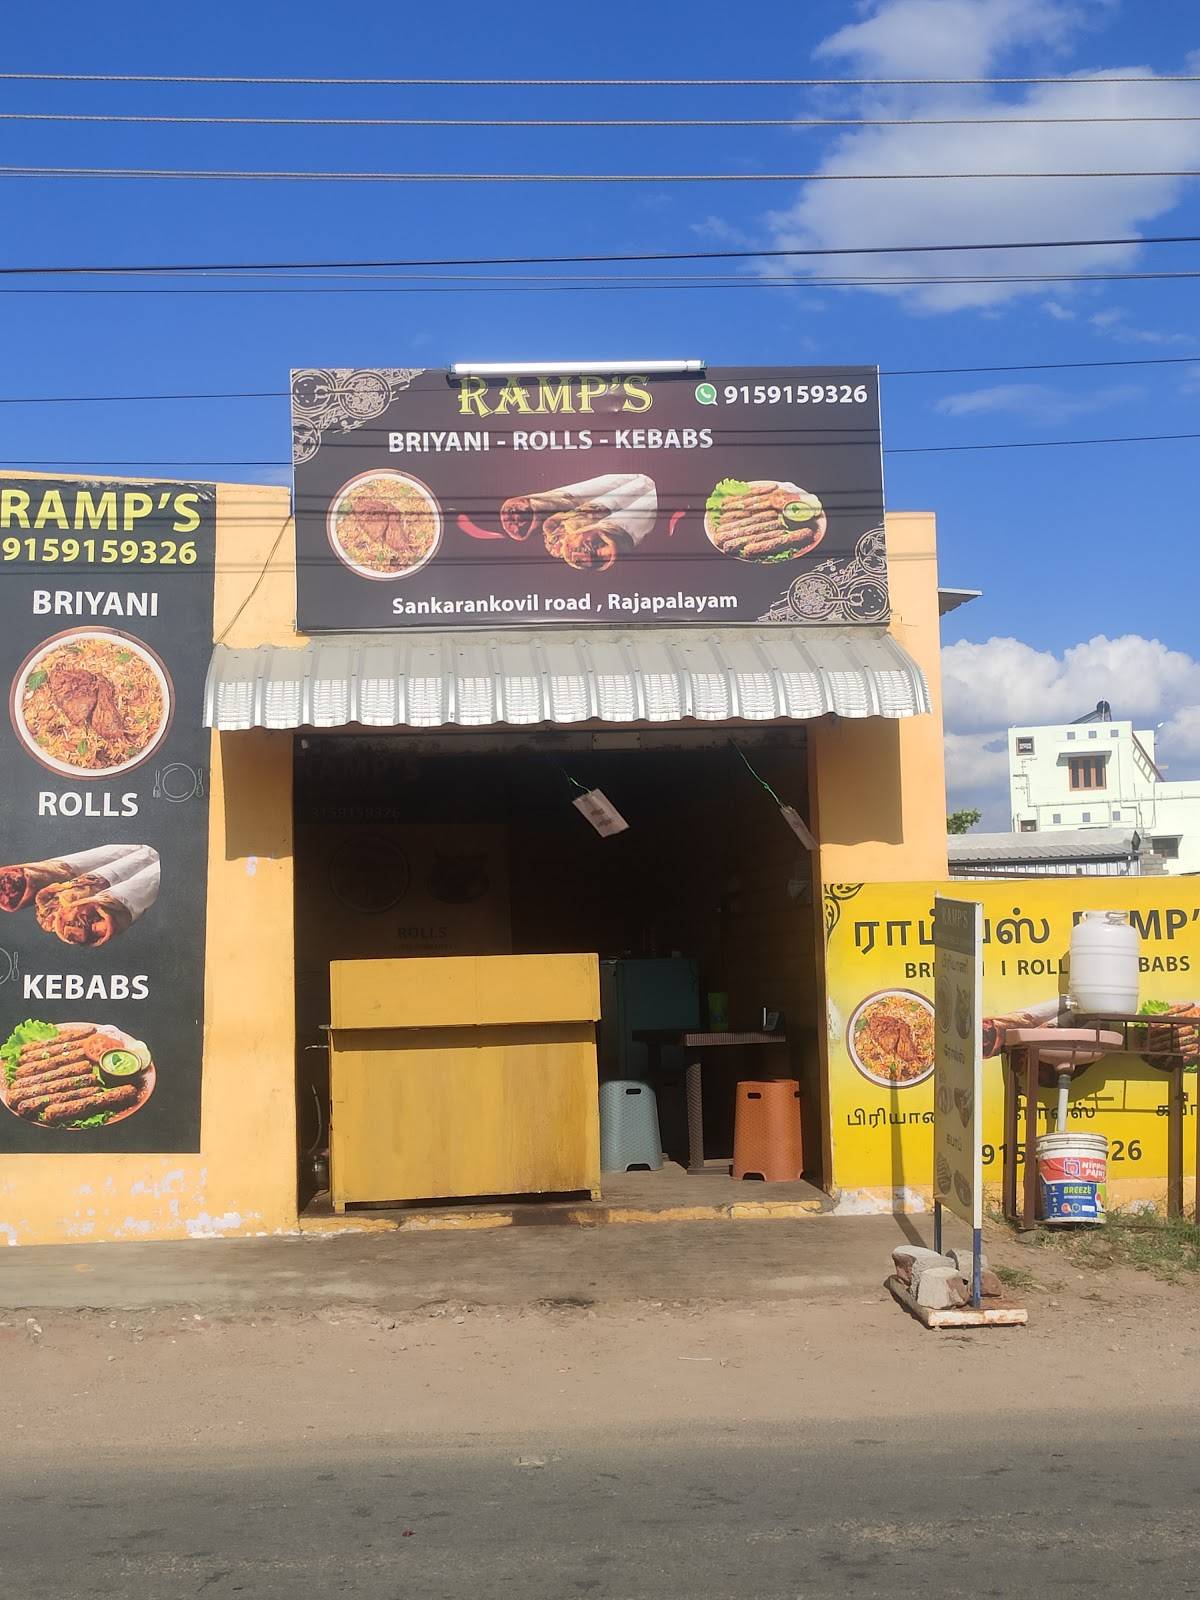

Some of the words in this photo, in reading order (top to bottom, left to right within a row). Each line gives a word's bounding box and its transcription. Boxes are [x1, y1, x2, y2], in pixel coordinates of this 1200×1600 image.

[457, 376, 653, 417] RAMP'S
[723, 385, 868, 404] 9159159326
[388, 431, 490, 453] BRIYANI
[513, 430, 593, 450] ROLLS
[615, 428, 713, 449] KEBABS
[1, 489, 200, 533] RAMP'S
[2, 538, 197, 565] 9159159326
[32, 590, 158, 617] BRIYANI
[392, 594, 539, 614] Sankarankovil
[544, 594, 591, 611] road
[607, 592, 738, 614] Rajapalayam
[38, 791, 139, 817] ROLLS
[1018, 959, 1069, 976] ROLL
[1138, 955, 1190, 973] BABS
[23, 974, 149, 1000] KEBABS
